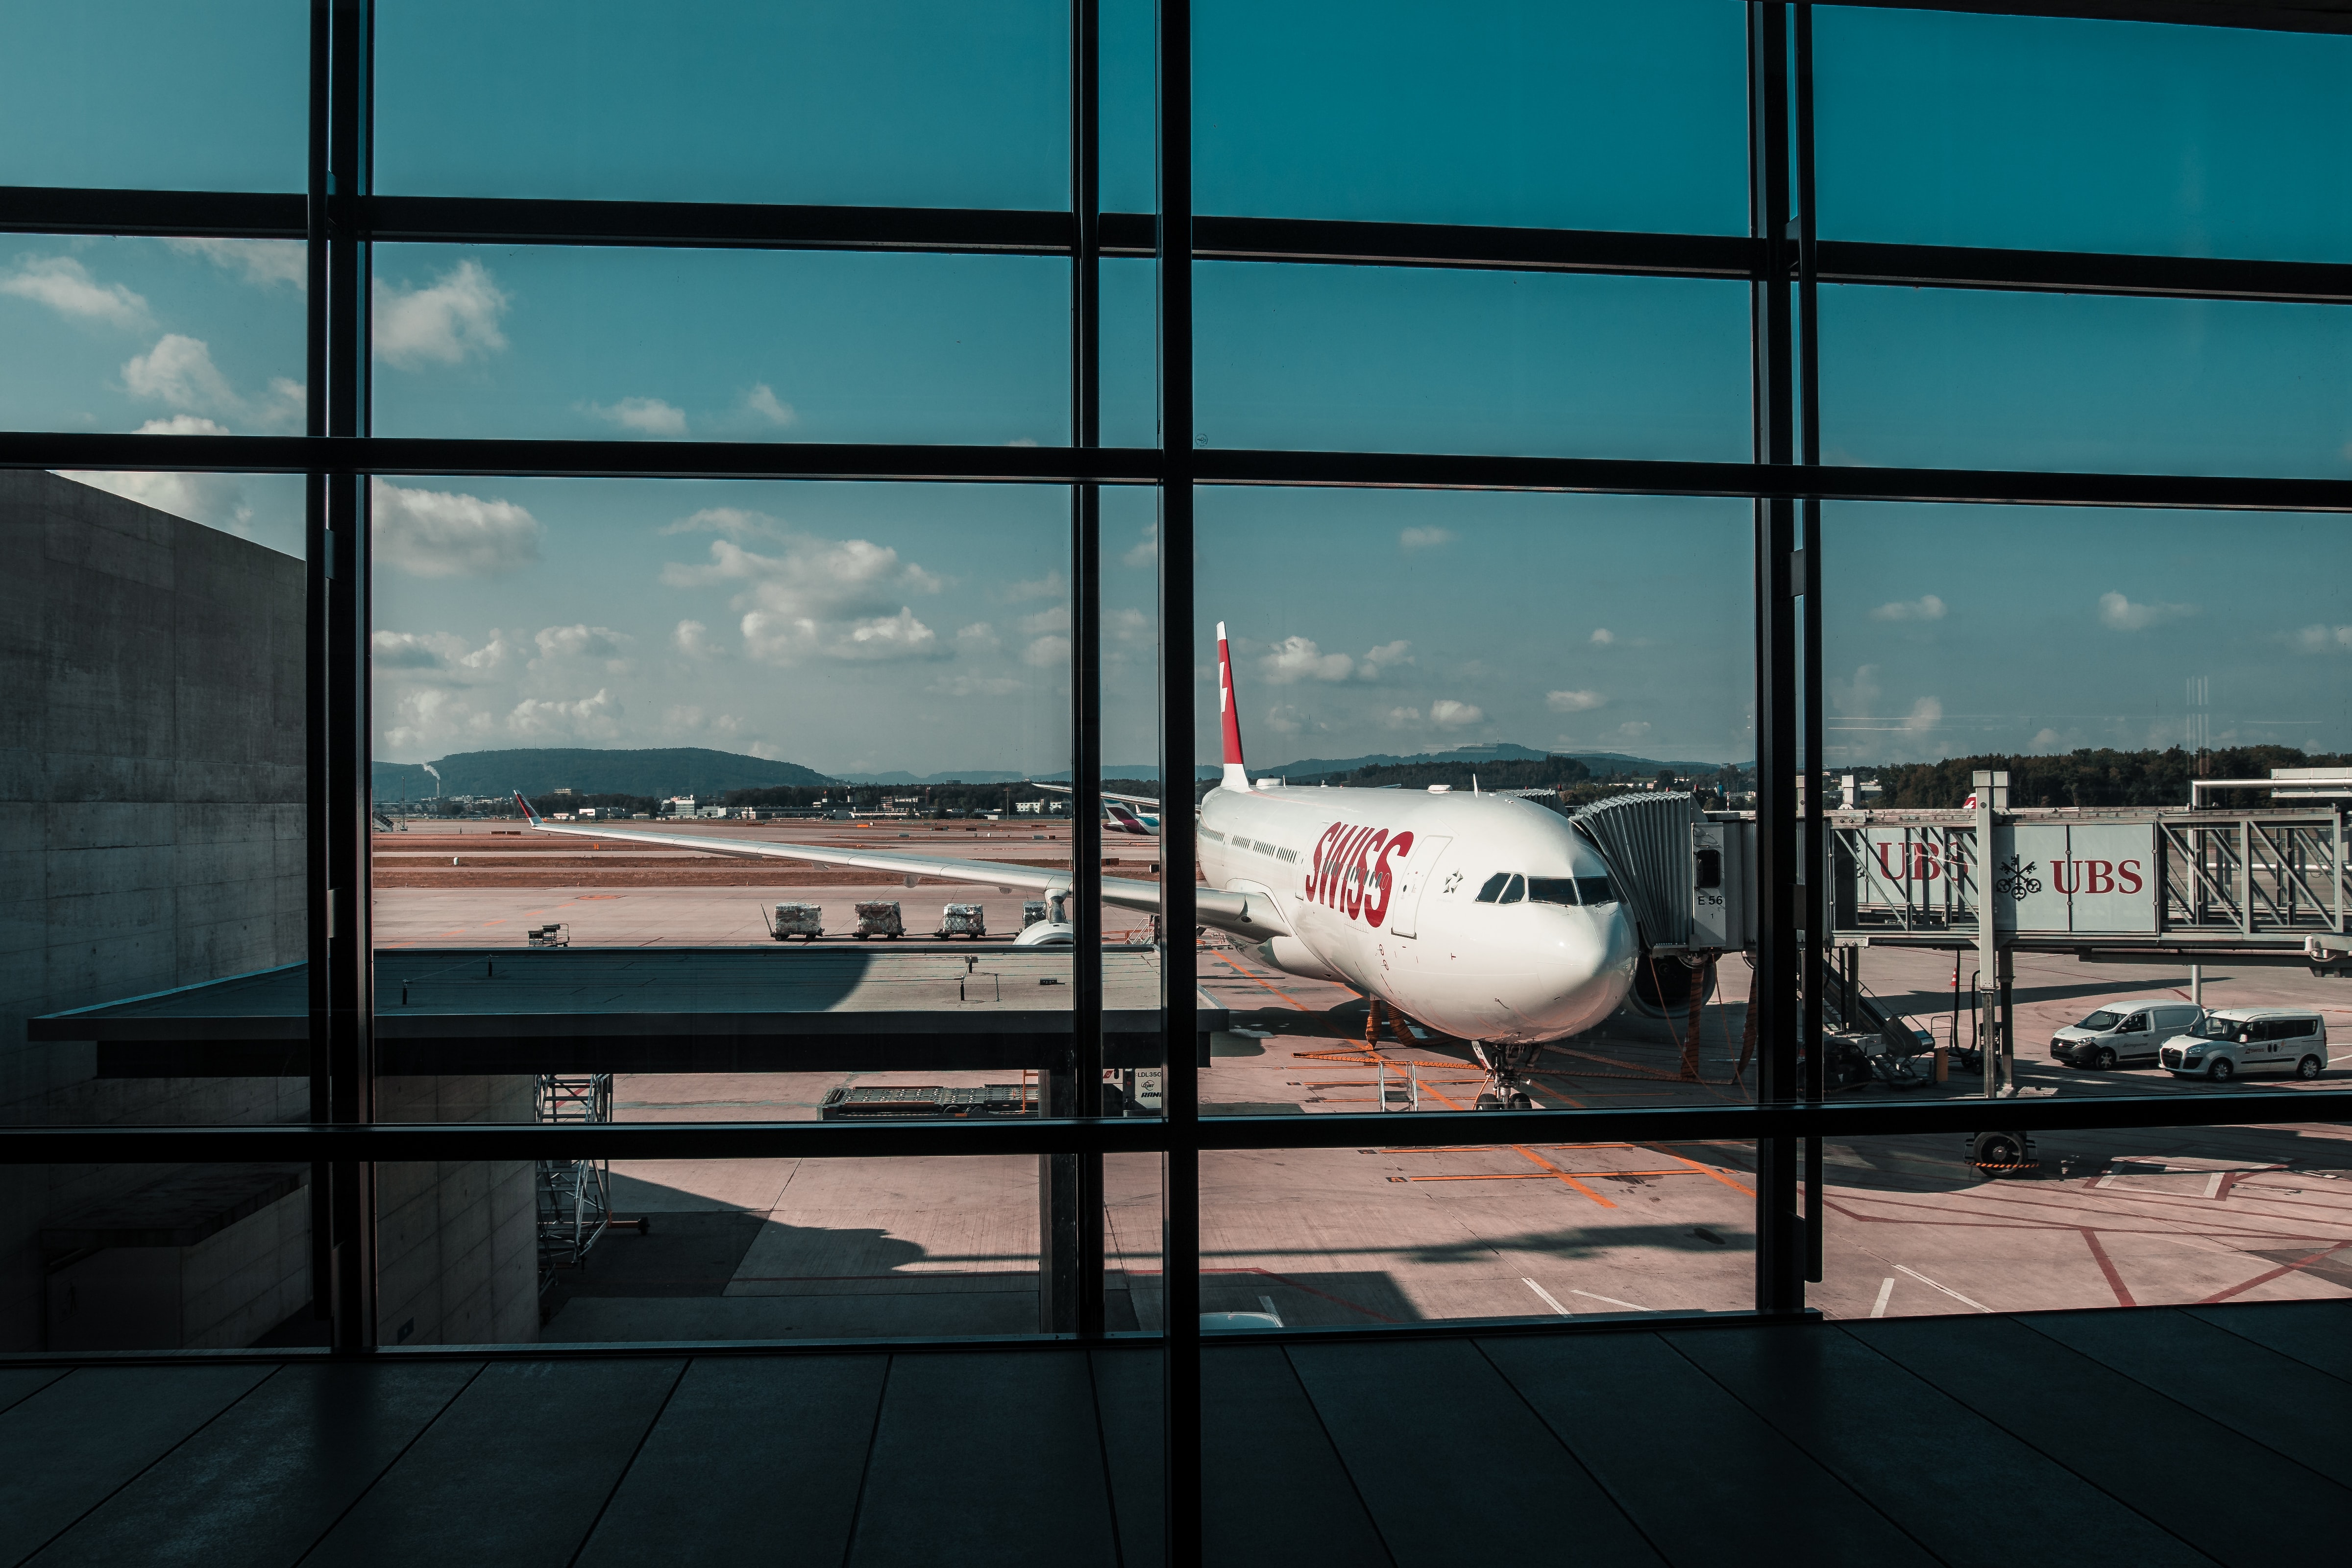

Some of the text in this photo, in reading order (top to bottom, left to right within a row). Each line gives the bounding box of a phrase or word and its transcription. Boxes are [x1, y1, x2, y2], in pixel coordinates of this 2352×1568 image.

[1305, 821, 1414, 928] SWISS
[2050, 859, 2143, 894] UBS
[1698, 895, 1723, 906] E 56
